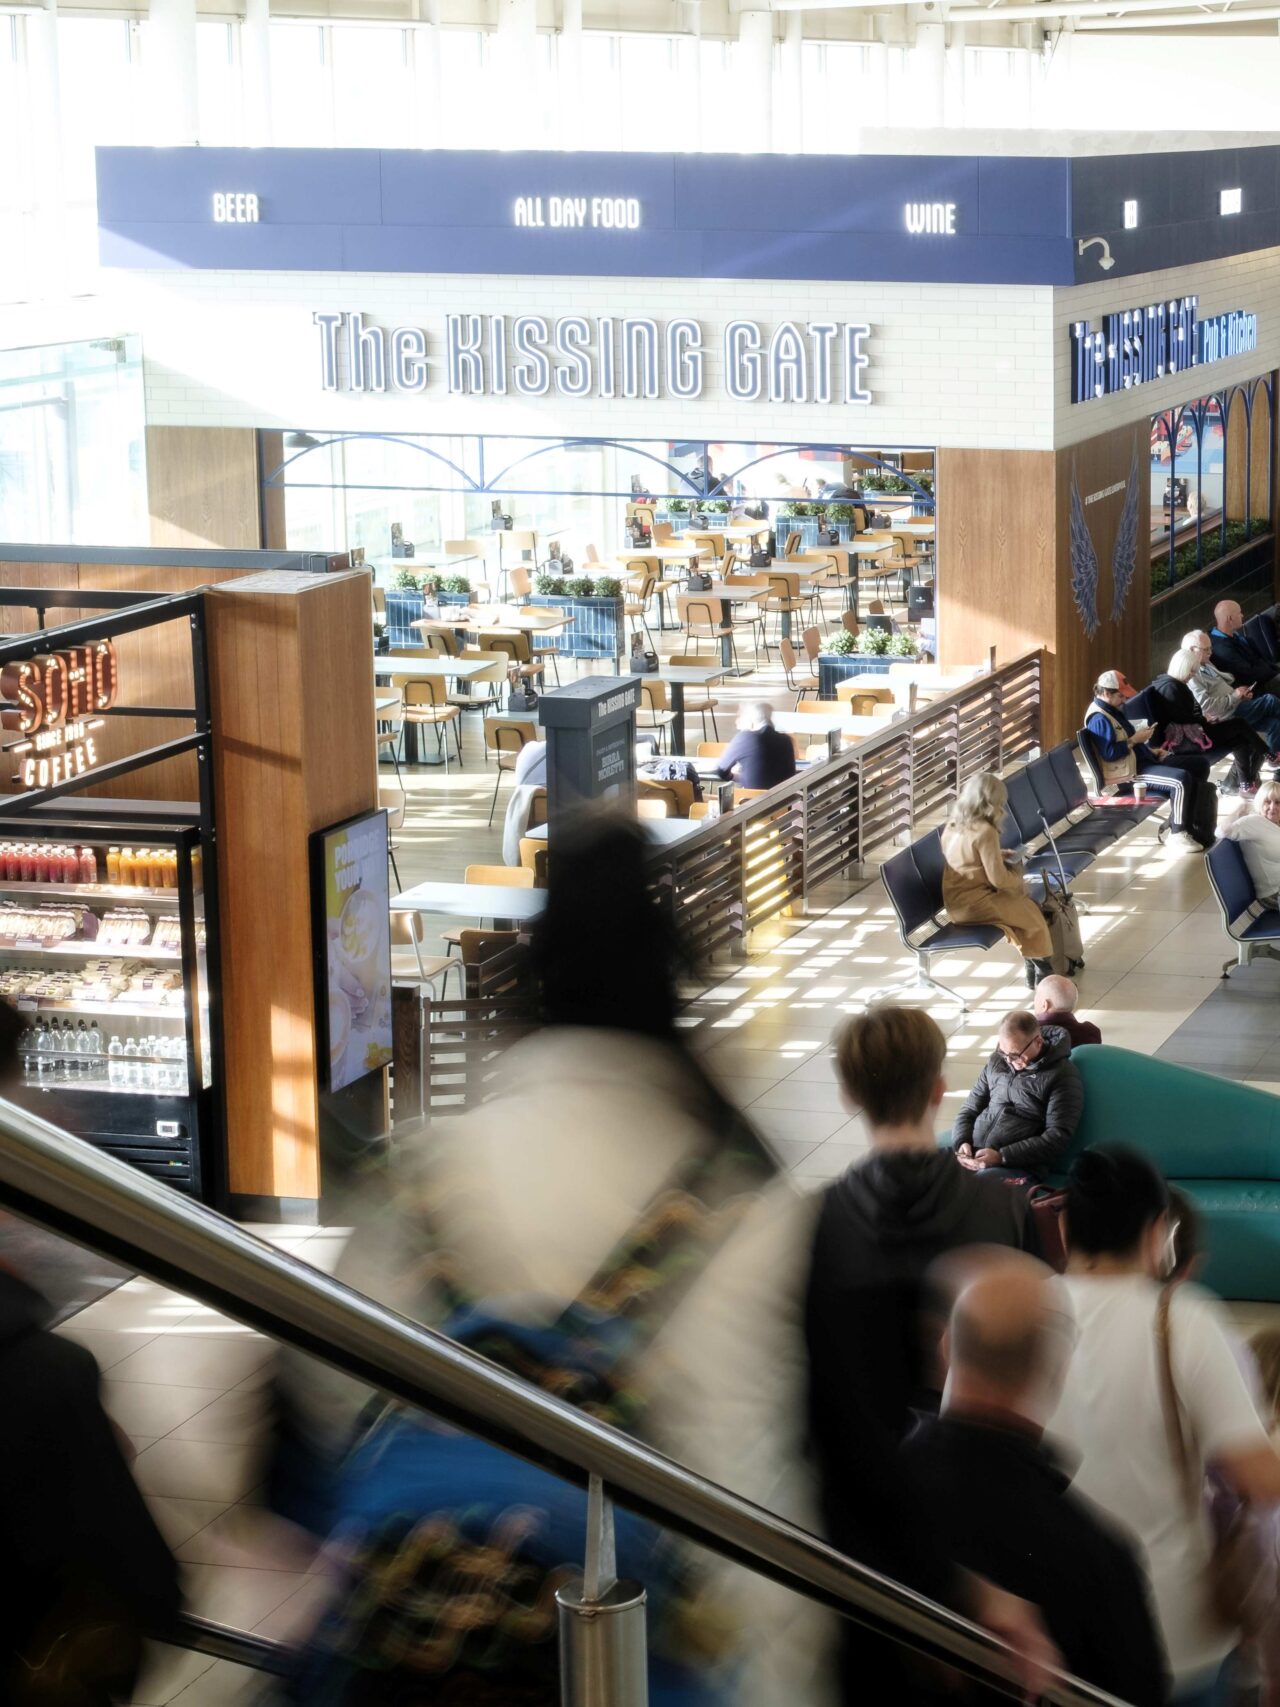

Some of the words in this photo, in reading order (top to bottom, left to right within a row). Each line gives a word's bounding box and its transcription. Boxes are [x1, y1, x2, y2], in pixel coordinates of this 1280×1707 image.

[212, 192, 259, 224] BEER
[514, 196, 545, 228] ALL
[549, 197, 586, 229] DAY
[592, 198, 640, 230] FOOD
[905, 203, 956, 234] WINE
[1203, 320, 1218, 364] Pub
[1228, 310, 1258, 357] Kitchen
[312, 312, 429, 392] The
[446, 314, 703, 400] KISSING
[724, 319, 873, 404] GATE
[1070, 321, 1105, 405] The
[2, 640, 118, 734] SOHO
[36, 729, 62, 751] SINCE
[24, 738, 97, 786] COFFEE
[598, 759, 624, 781] MORETTI
[601, 750, 620, 768] BIRRA
